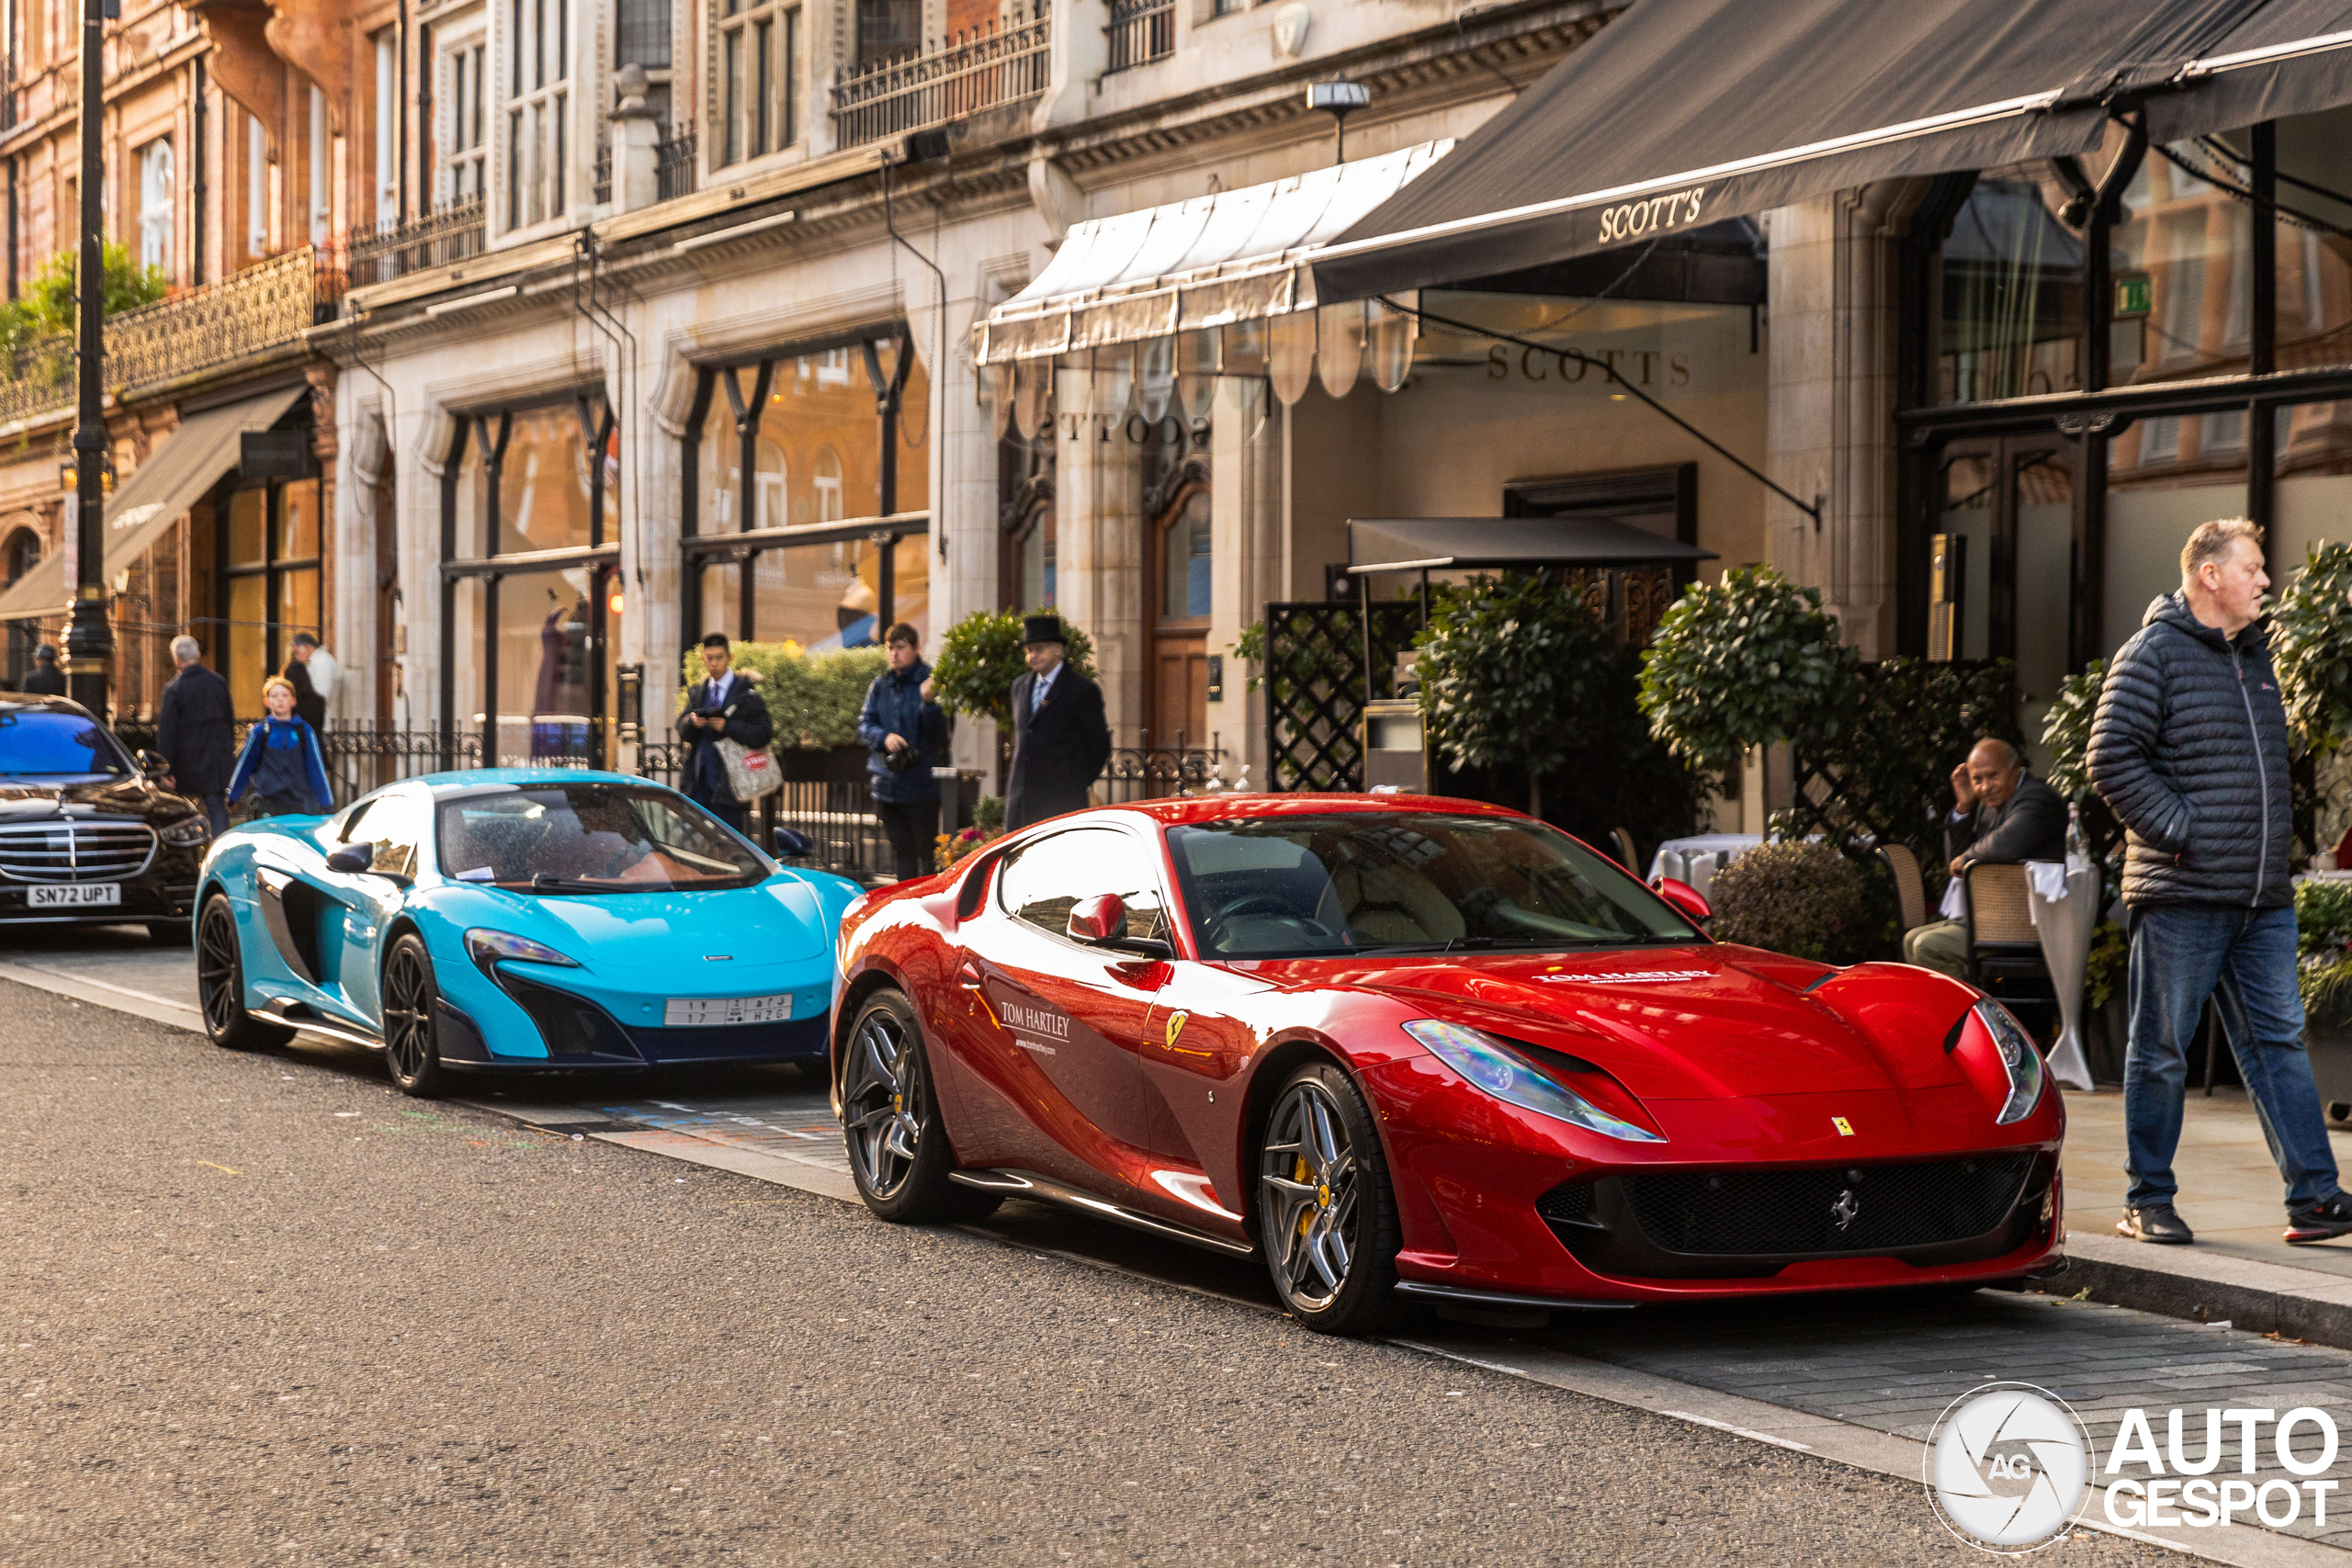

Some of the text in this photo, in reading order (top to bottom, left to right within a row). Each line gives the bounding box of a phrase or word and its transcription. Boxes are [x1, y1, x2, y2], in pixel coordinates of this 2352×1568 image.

[1599, 186, 1704, 243] SCOTT'S
[1487, 344, 1690, 386] SCOTTS
[36, 886, 114, 903] SN72 UPT
[1001, 1001, 1069, 1037] TOM HARTLEY
